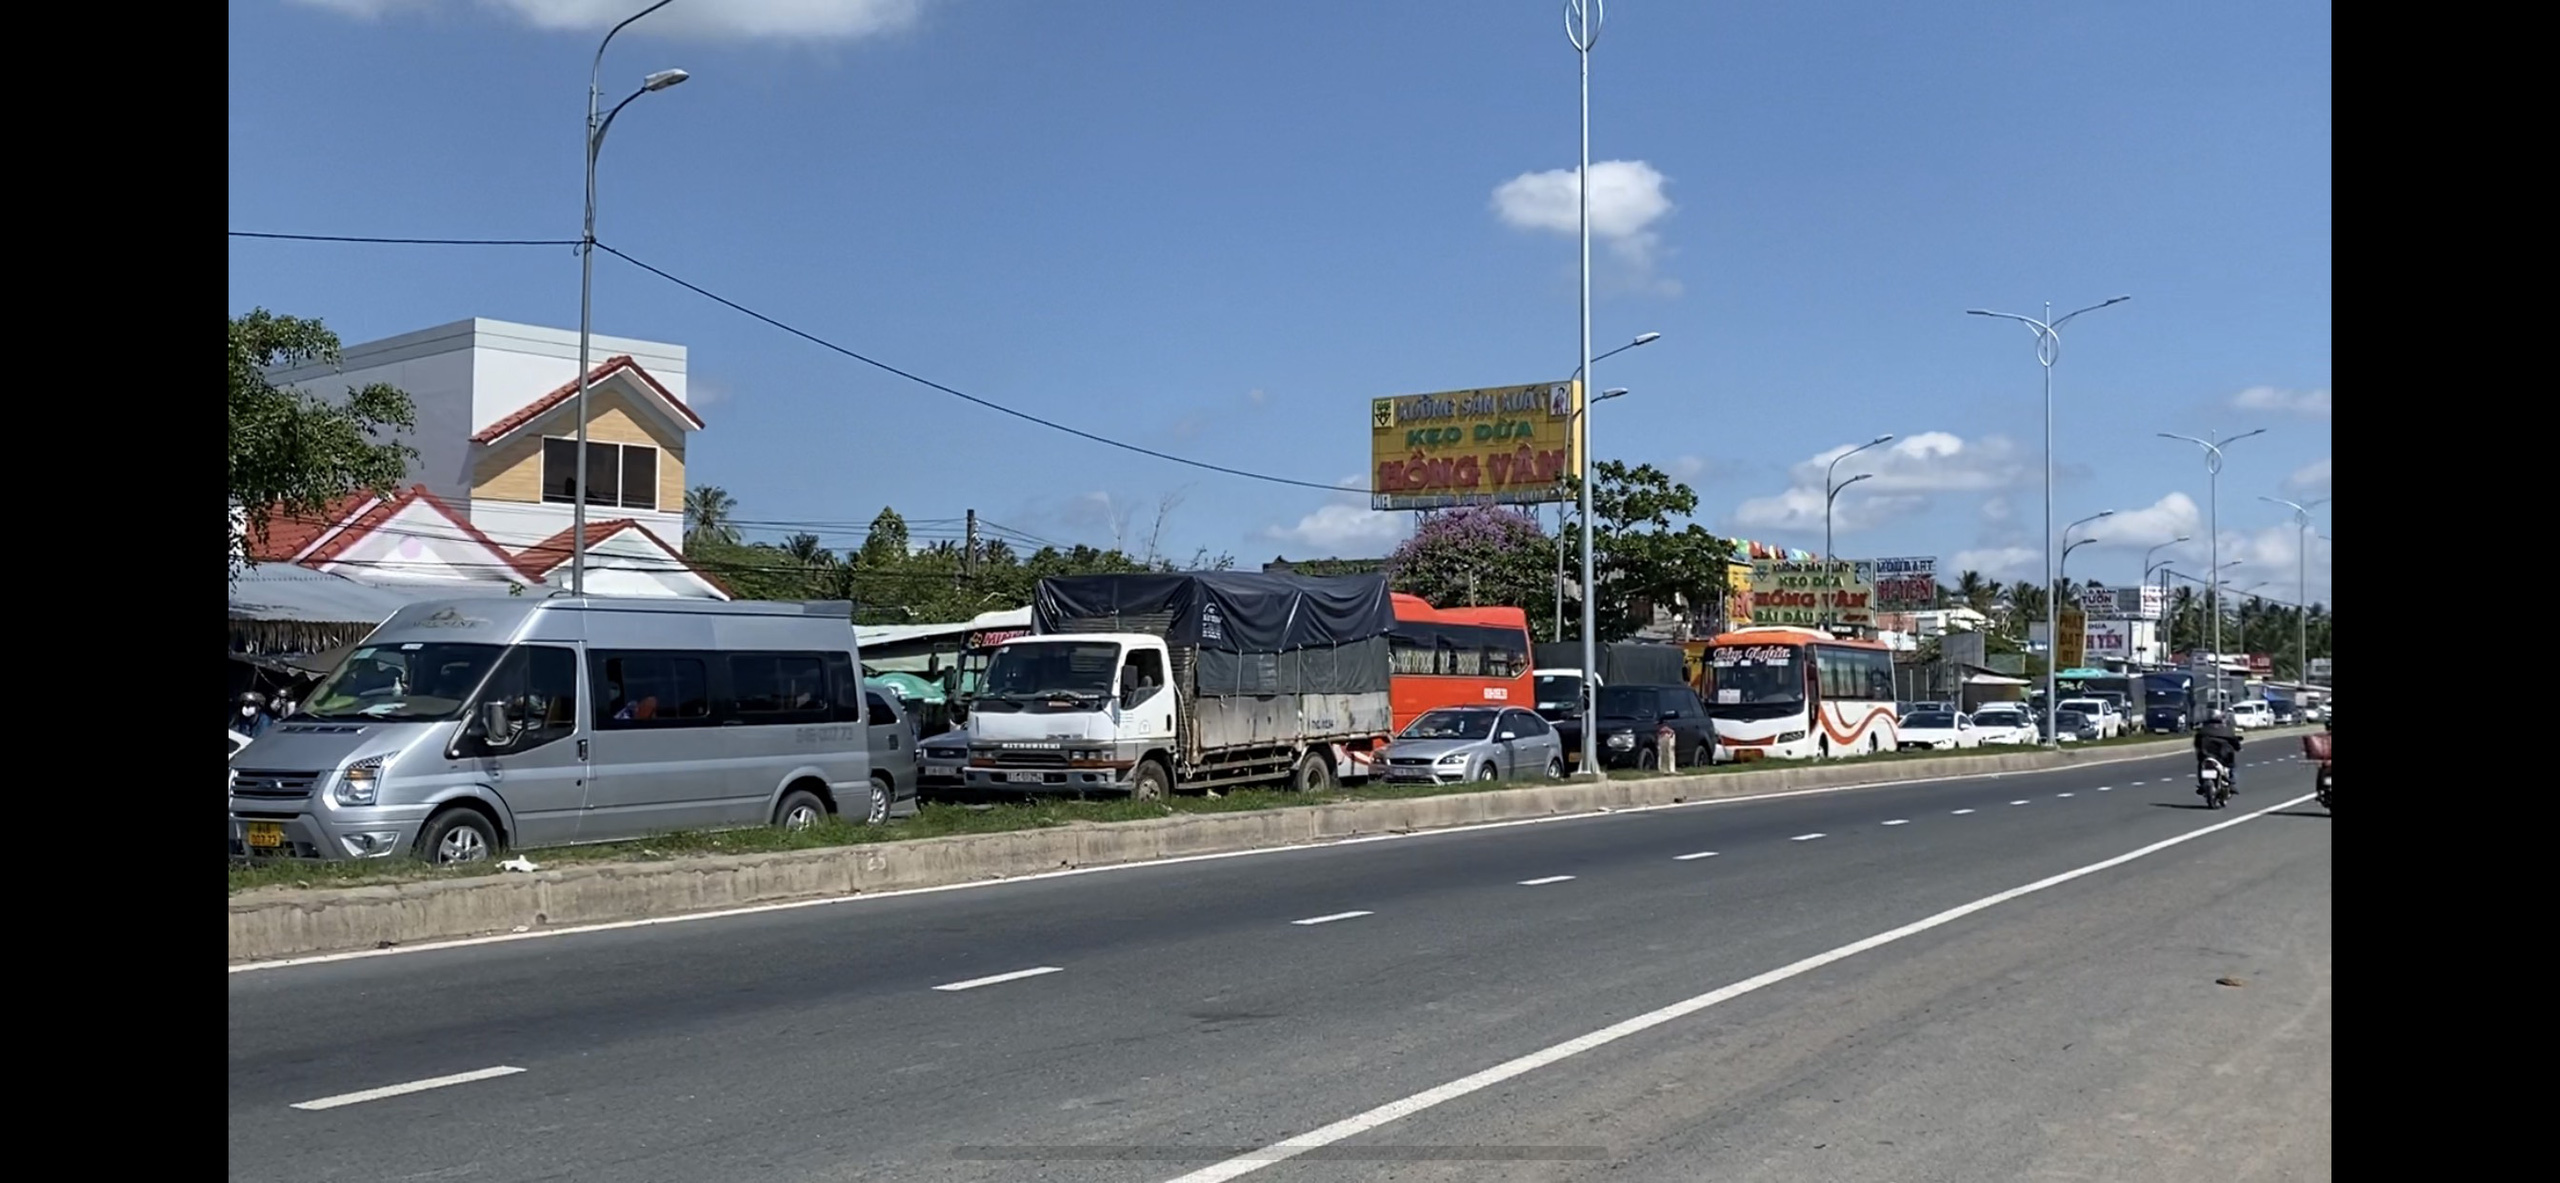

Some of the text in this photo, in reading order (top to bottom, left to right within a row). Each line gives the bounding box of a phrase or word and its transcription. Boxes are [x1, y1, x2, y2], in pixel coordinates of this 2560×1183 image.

[1405, 418, 1534, 448] KẸO DỪA
[1487, 442, 1566, 486] VÂN
